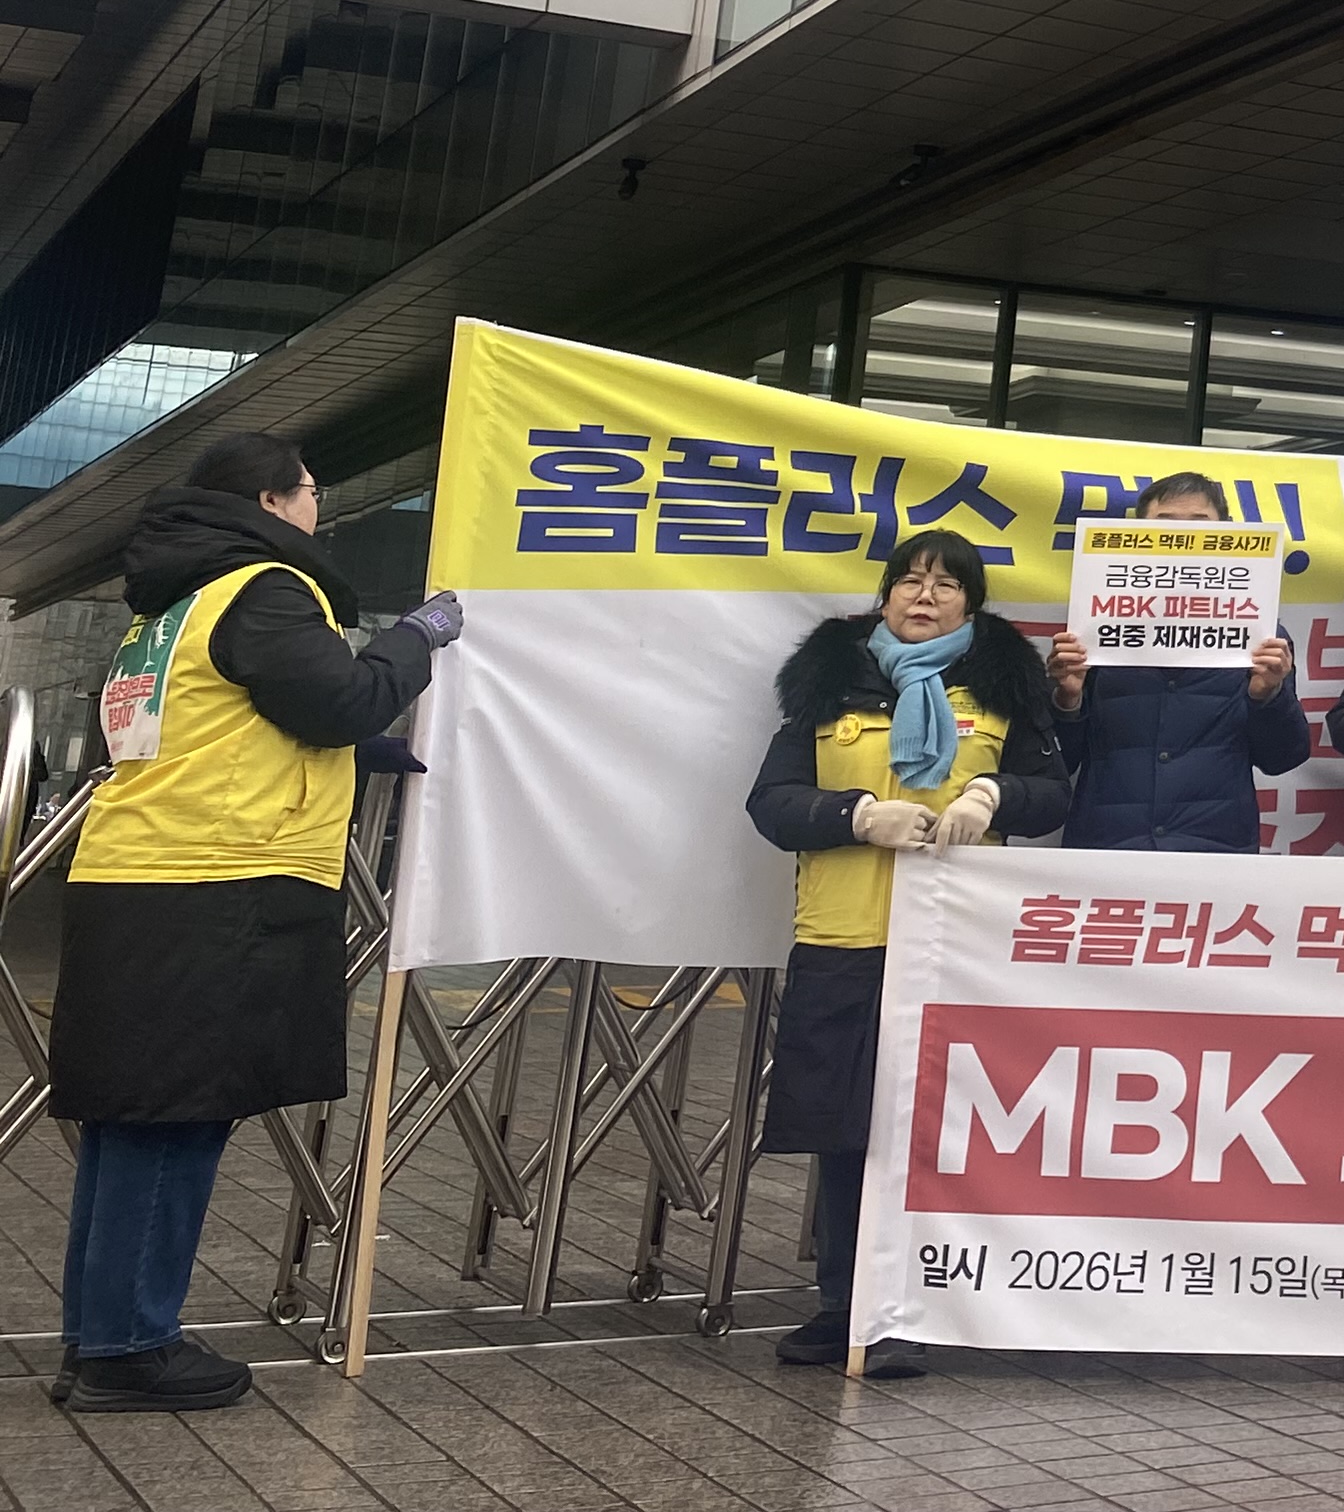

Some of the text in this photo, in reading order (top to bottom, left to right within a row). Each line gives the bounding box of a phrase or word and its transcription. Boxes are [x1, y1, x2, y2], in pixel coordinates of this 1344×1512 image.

[515, 424, 1018, 566] 홈플러스
[1091, 532, 1271, 551] 홈플러스 먹튀! 금융사기!
[1105, 564, 1250, 590] 금융감독원은
[1091, 595, 1259, 620] MBK 파트너스
[1098, 625, 1145, 648] 엄중
[1153, 626, 1250, 650] 제재하라
[1010, 893, 1275, 968] 홈플러스
[936, 1041, 1314, 1187] MBK
[918, 1243, 988, 1292] 일시
[1009, 1249, 1148, 1296] 2026년
[1160, 1251, 1216, 1298] 1월
